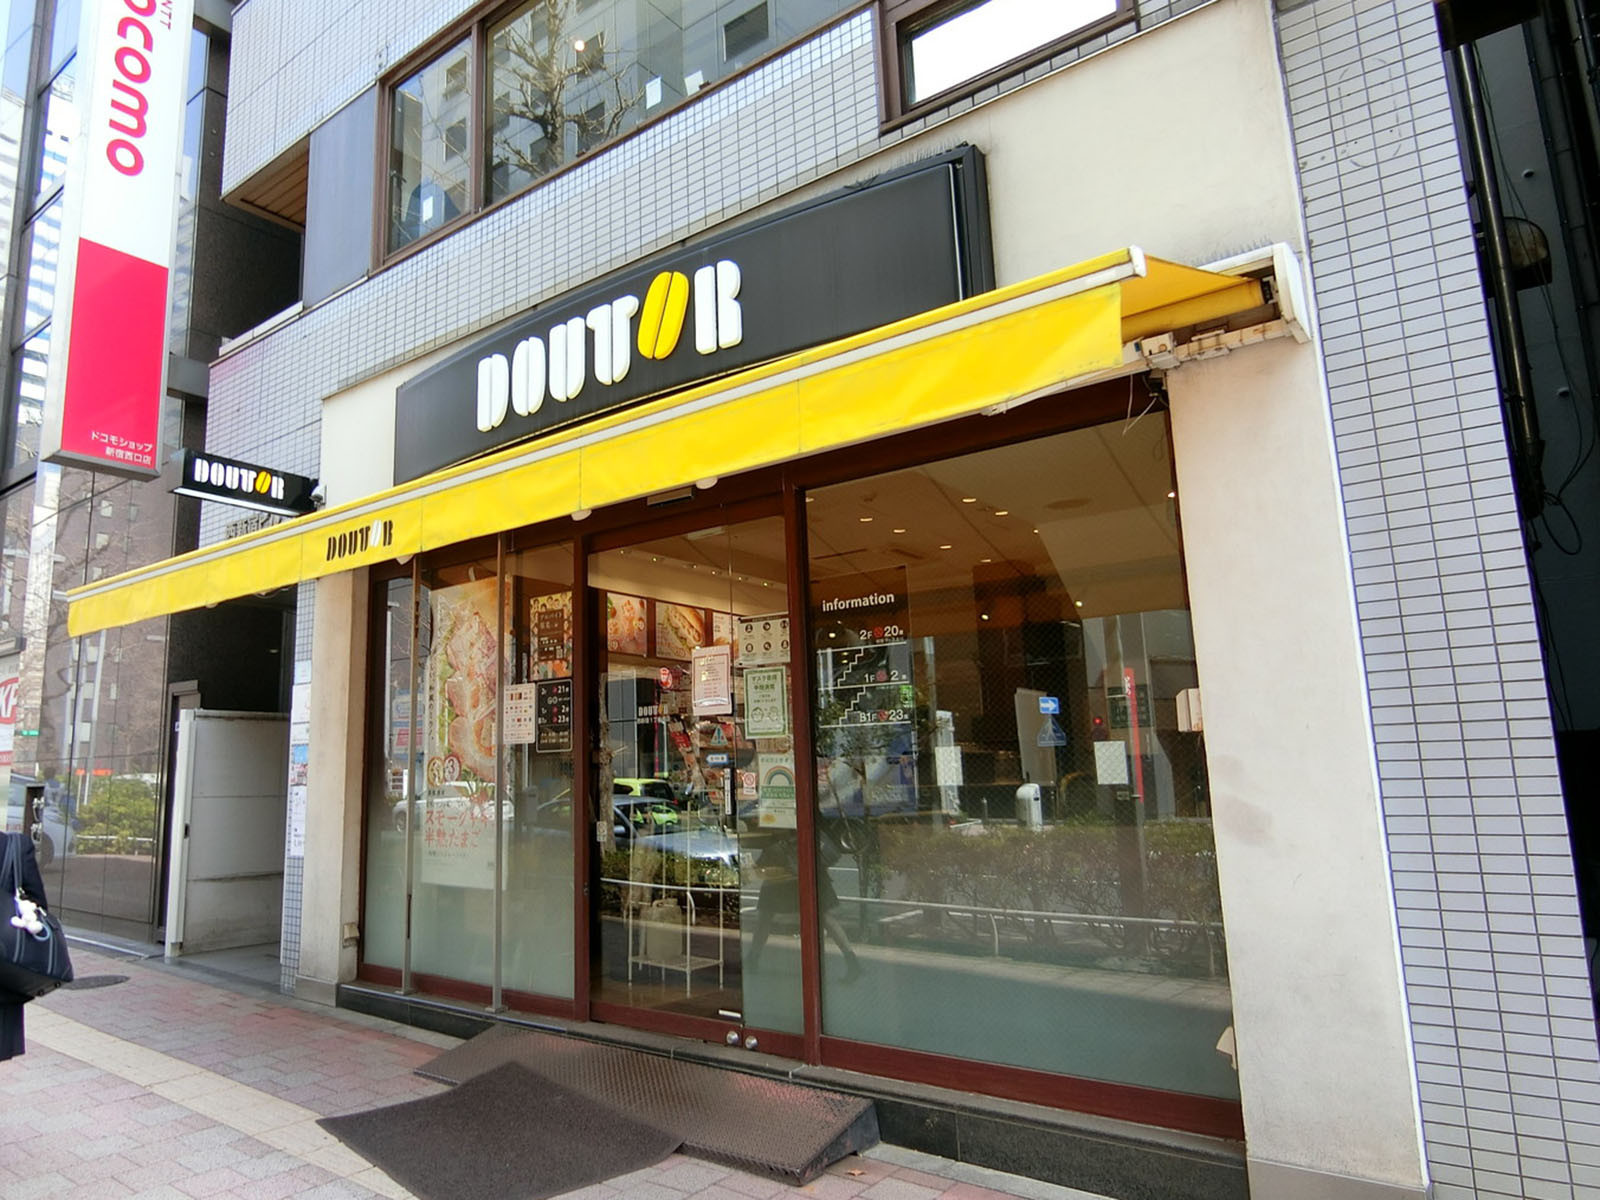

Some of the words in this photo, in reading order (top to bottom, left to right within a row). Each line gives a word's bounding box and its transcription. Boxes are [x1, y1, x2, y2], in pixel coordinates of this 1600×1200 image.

[477, 259, 742, 432] DOUTOR
[91, 431, 153, 453] ドコモショップ
[105, 446, 152, 465] 新宿西口店
[194, 458, 285, 500] DOUTOR
[326, 519, 393, 561] DOUTOR
[822, 593, 895, 612] information
[860, 630, 873, 640] 2F
[864, 673, 875, 683] 1F
[860, 712, 877, 722] B1F
